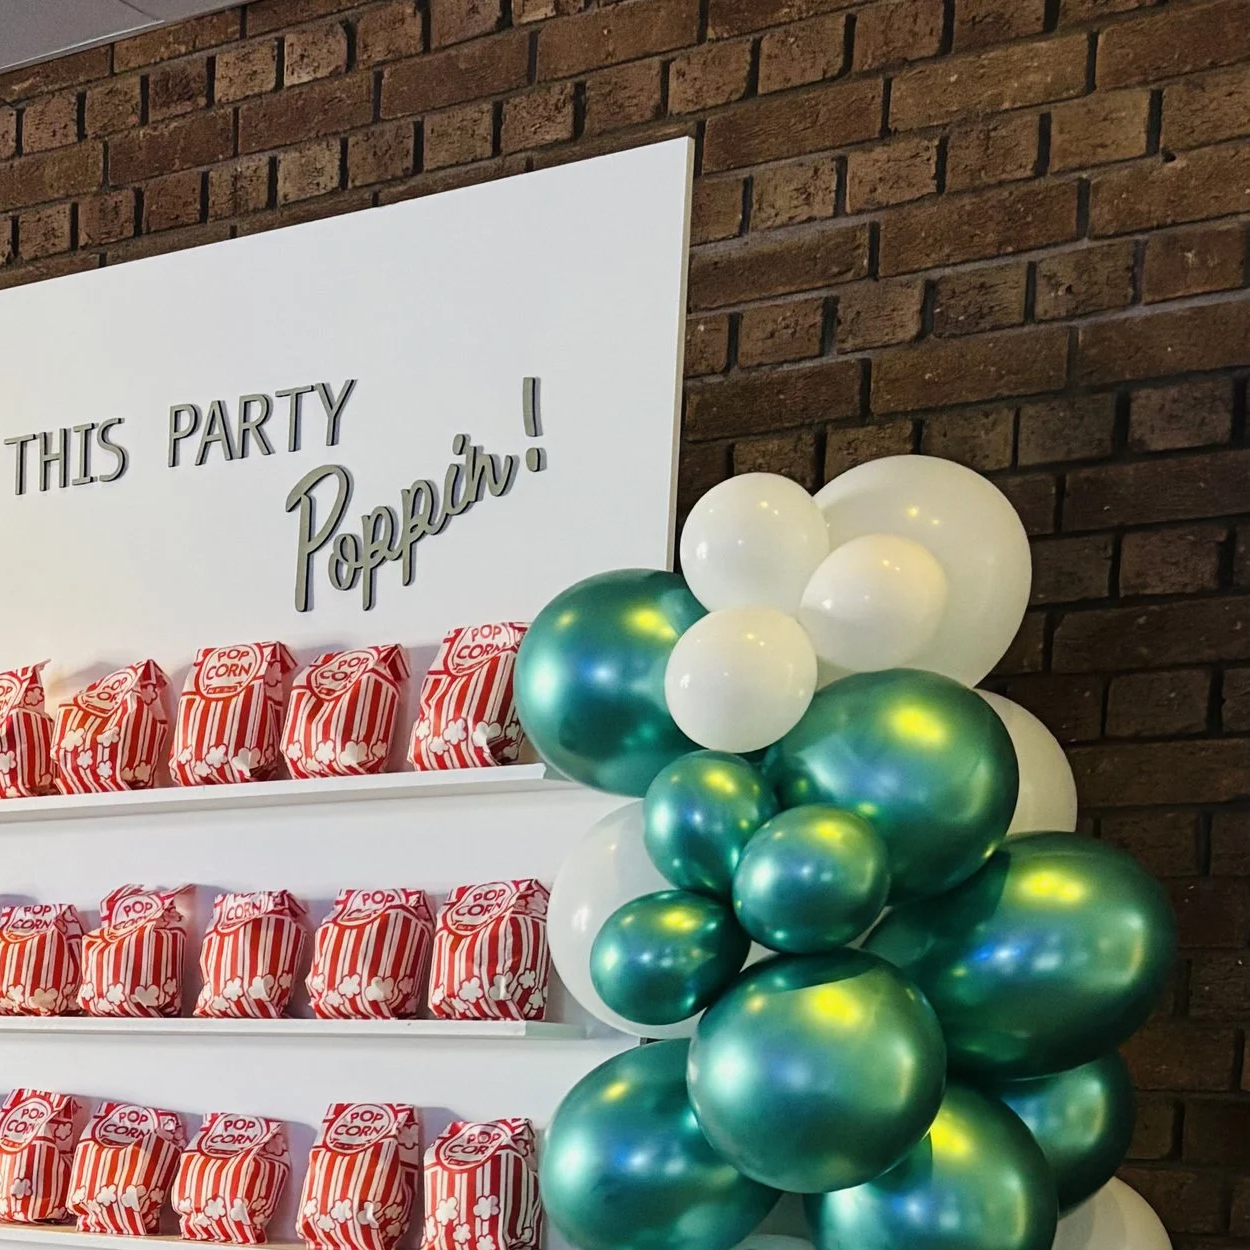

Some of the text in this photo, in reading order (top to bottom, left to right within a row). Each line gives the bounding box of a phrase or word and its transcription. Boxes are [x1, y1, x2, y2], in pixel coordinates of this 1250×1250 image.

[3, 417, 130, 496] THIS
[168, 379, 357, 468] PARTY
[471, 625, 501, 641] POP
[218, 650, 249, 661] POP
[457, 643, 506, 659] CORN
[338, 657, 369, 669] POP
[206, 663, 252, 680] CORN
[362, 891, 395, 906] POP
[473, 888, 505, 901] POP
[23, 906, 51, 916] POP
[123, 901, 153, 917] POP
[226, 901, 262, 920] CORN
[456, 903, 503, 917] CORN
[12, 919, 54, 929] CORN
[21, 1109, 45, 1120] POP
[118, 1111, 149, 1123] POP
[350, 1110, 384, 1122] POP
[103, 1124, 151, 1139] CORN
[224, 1120, 256, 1132] POP
[334, 1125, 384, 1136] CORN
[210, 1134, 256, 1144] CORN
[466, 1131, 502, 1144] POP
[449, 1145, 488, 1154] COR
